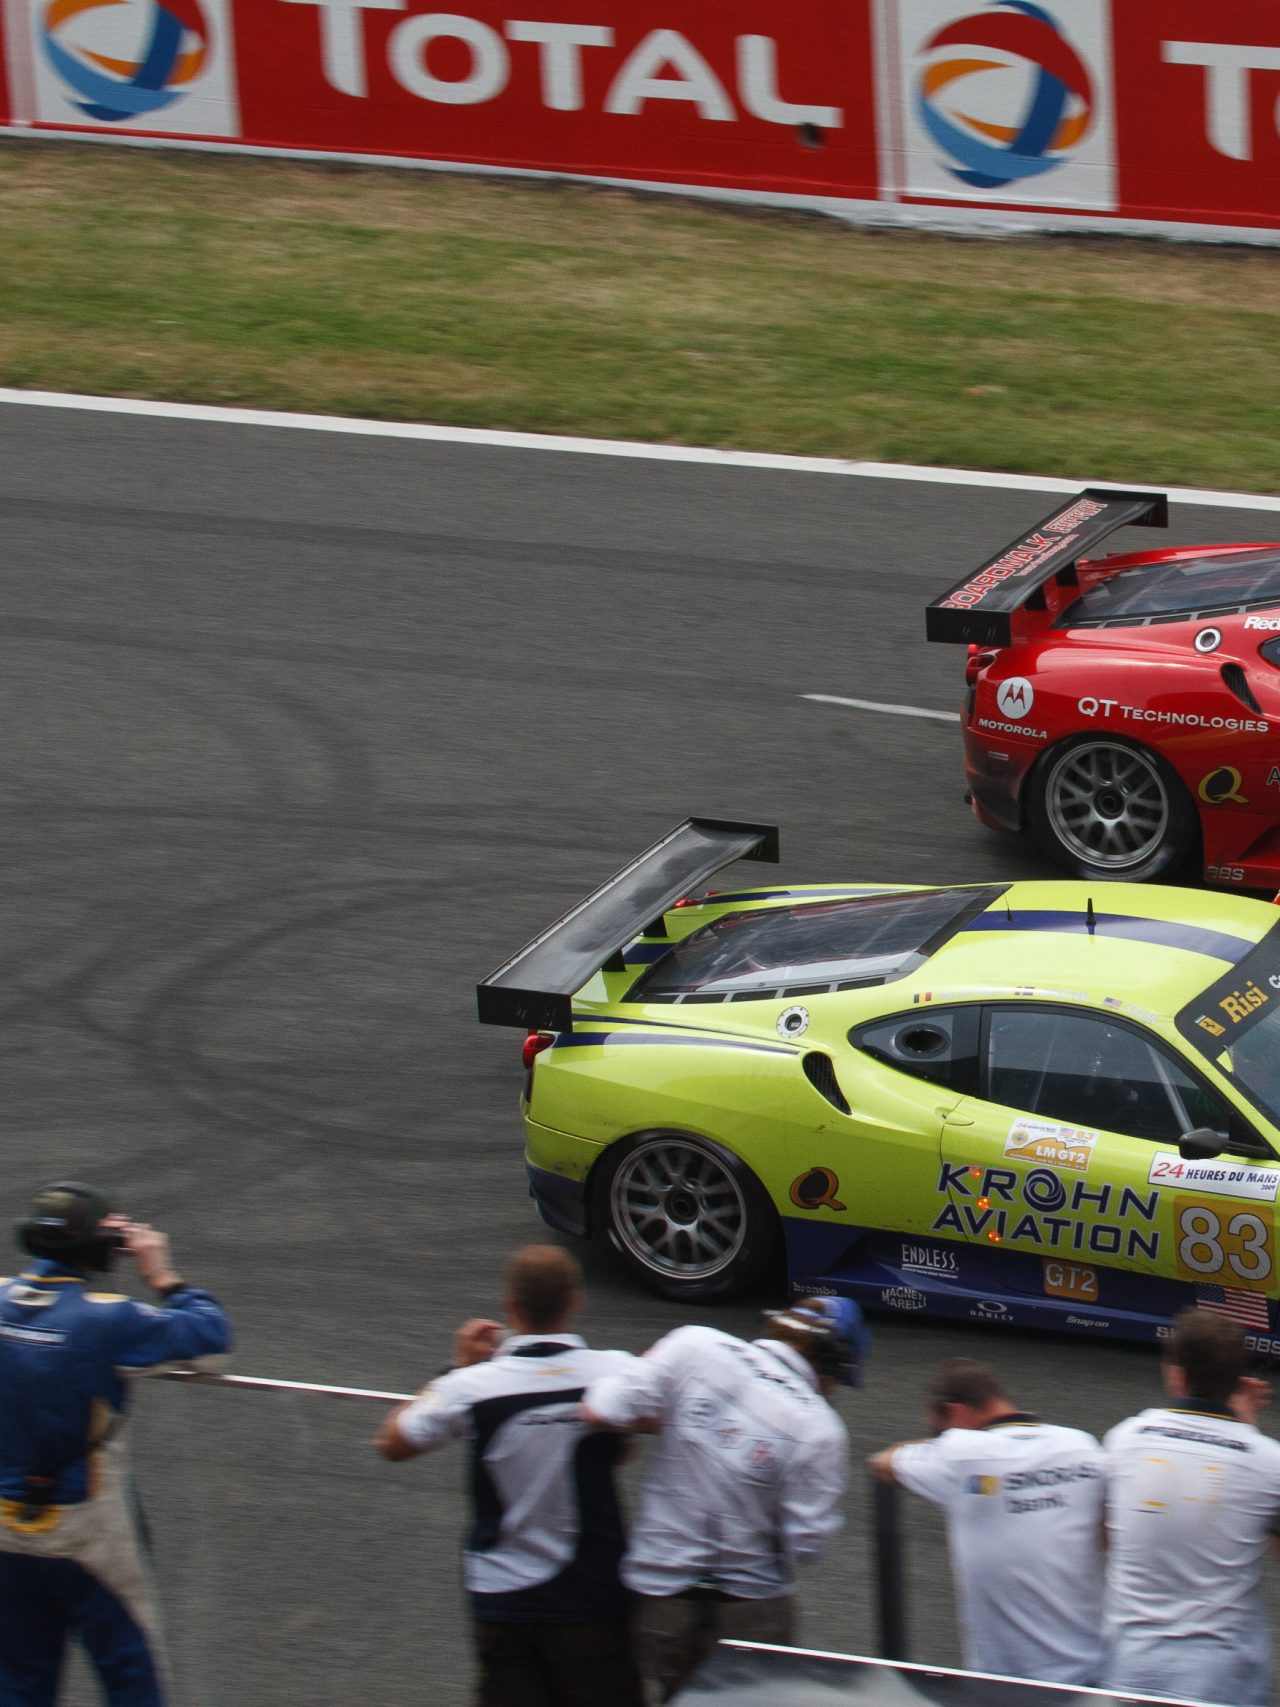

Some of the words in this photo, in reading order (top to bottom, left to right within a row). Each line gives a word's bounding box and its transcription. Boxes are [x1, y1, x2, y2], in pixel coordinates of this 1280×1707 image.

[285, 0, 843, 128] TOTAL
[978, 718, 1048, 740] MOTOROLA
[1077, 696, 1117, 719] QT
[1120, 705, 1269, 732] TECHNOLOGIES
[1219, 980, 1269, 1024] Risi
[1152, 1162, 1184, 1179] 24
[1186, 1168, 1226, 1182] HEURES
[1228, 1171, 1244, 1182] DU
[1246, 1172, 1279, 1184] MANS
[937, 1162, 1161, 1223] KROHN
[932, 1203, 1159, 1260] AVIATION
[1177, 1205, 1273, 1281] 83
[902, 1244, 956, 1269] ENDLESS
[793, 1281, 837, 1296] brembo
[1044, 1263, 1097, 1294] GT2
[970, 1309, 1014, 1321] OAKLEY
